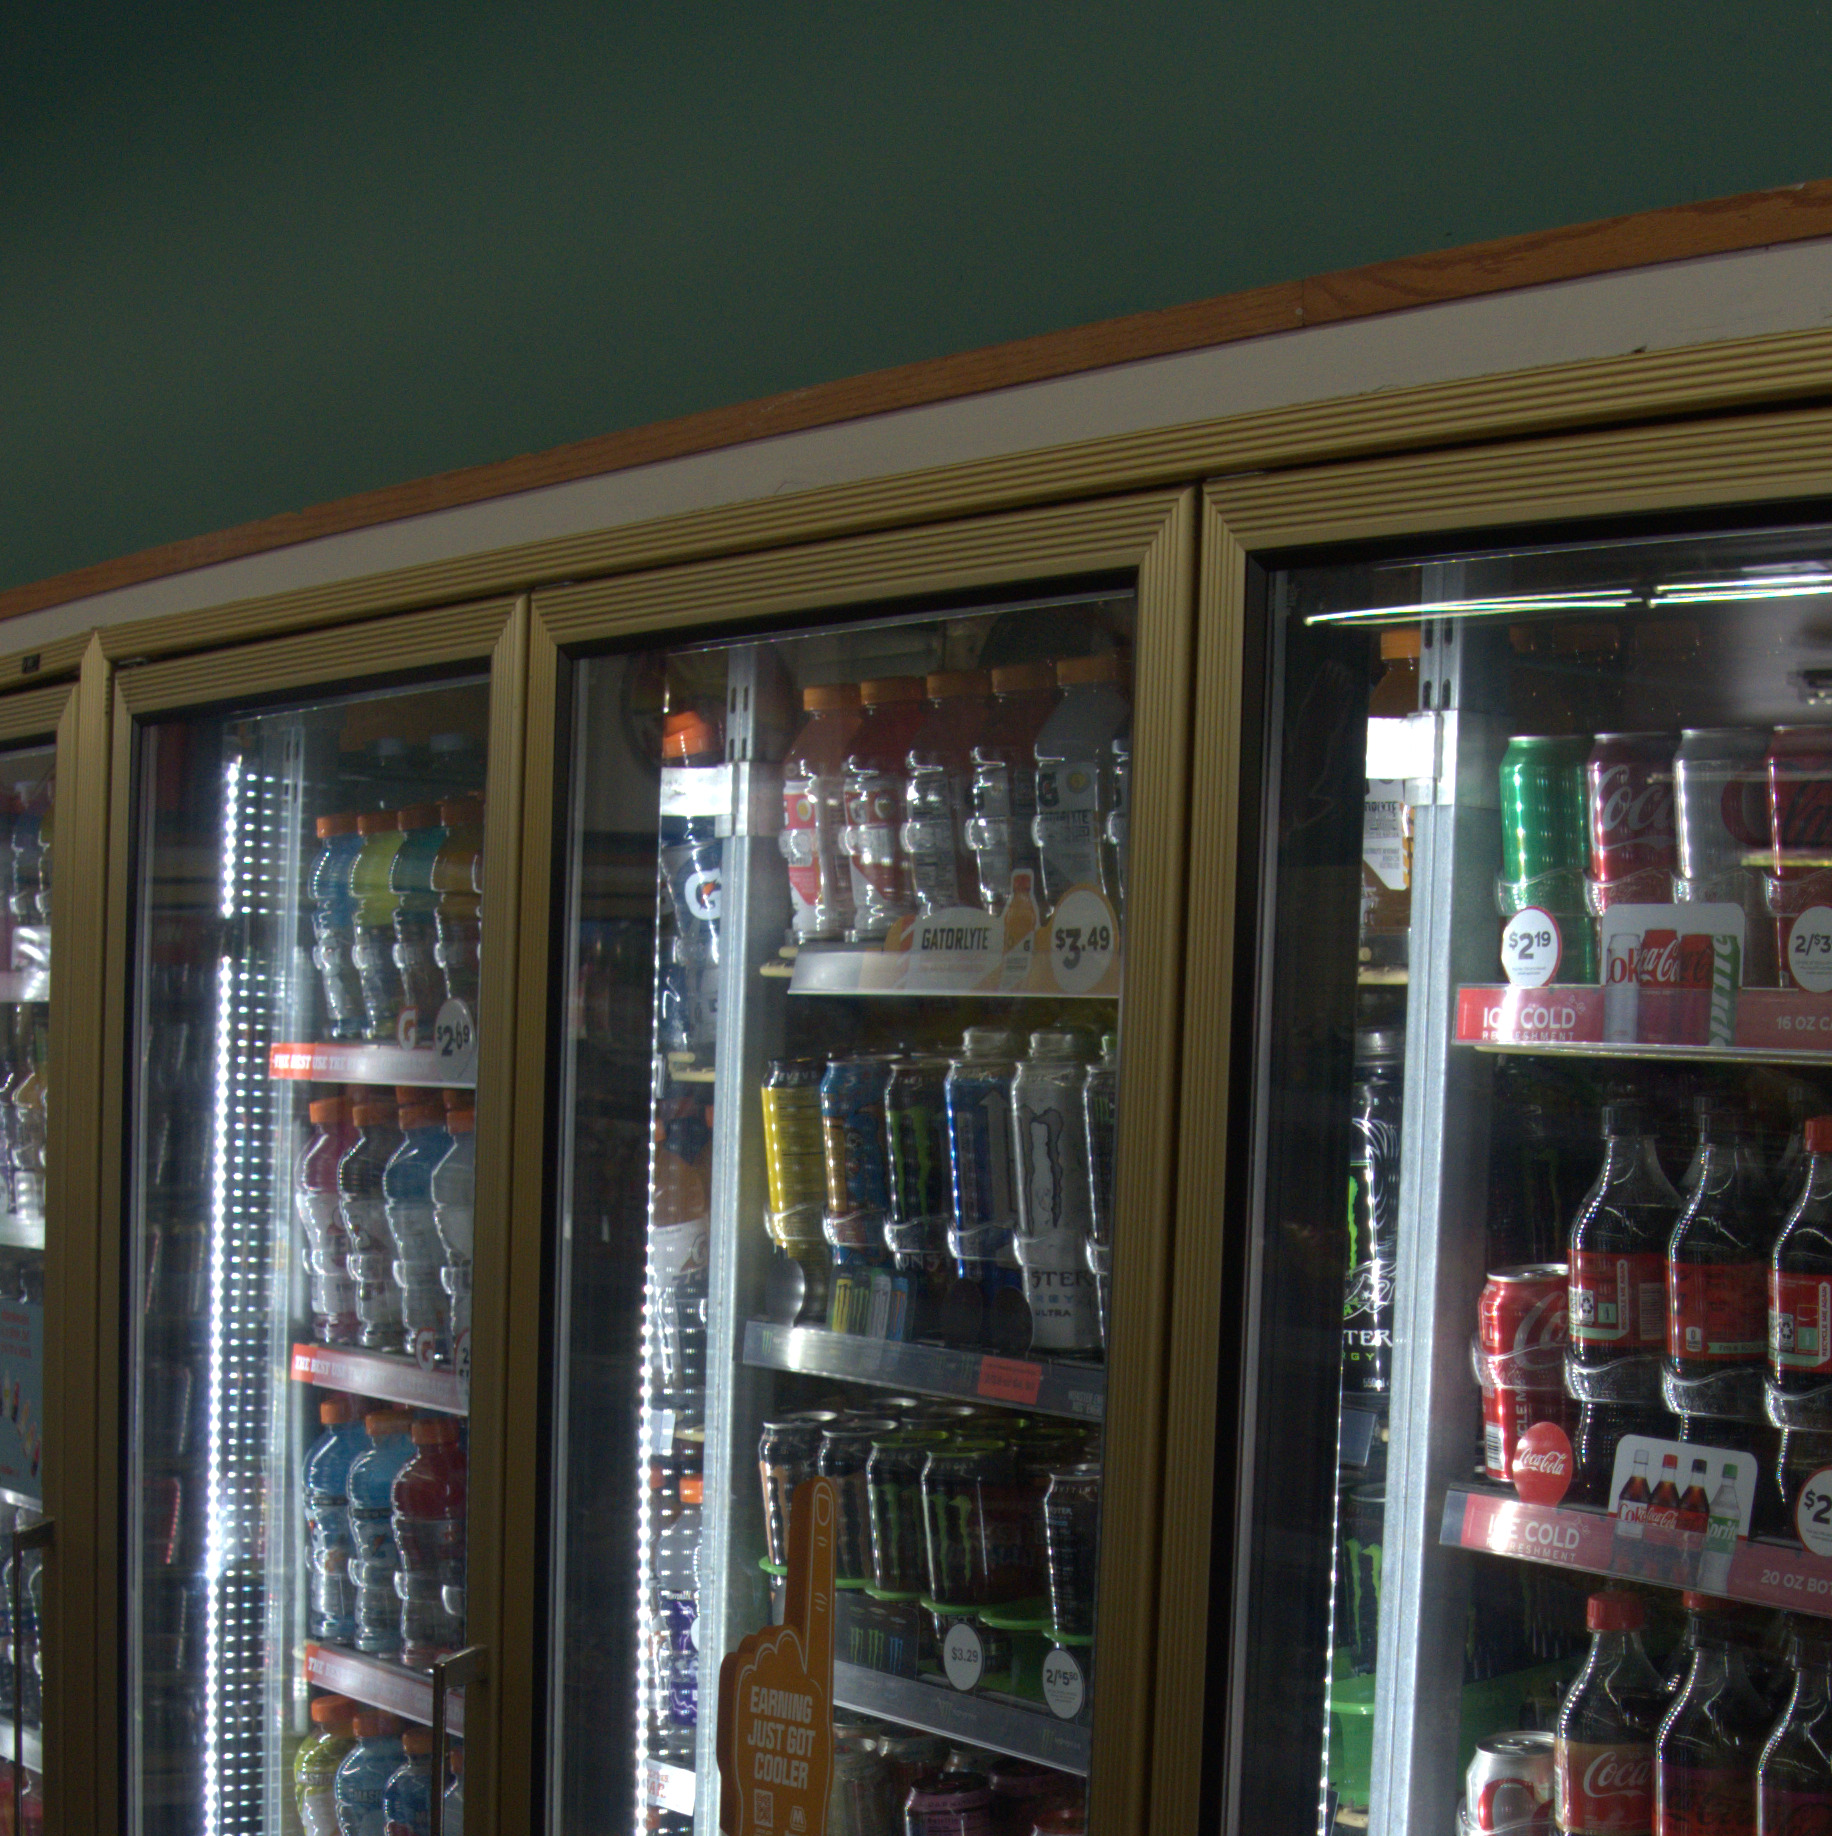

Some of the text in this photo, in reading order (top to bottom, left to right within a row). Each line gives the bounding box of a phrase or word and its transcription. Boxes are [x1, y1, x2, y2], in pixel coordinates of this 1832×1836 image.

[921, 927, 990, 952] GATORLYTE
[1055, 927, 1111, 969] $3.49
[1776, 1016, 1792, 1031] 16
[1795, 1016, 1815, 1031] OZ
[1525, 1521, 1580, 1550] COLD
[1760, 1569, 1780, 1585] 20
[1783, 1572, 1803, 1590] OZ
[950, 1645, 979, 1664] $3.29
[750, 1685, 814, 1724] EARNING
[747, 1725, 816, 1756] JUST GOT
[753, 1753, 809, 1791] COOLER
